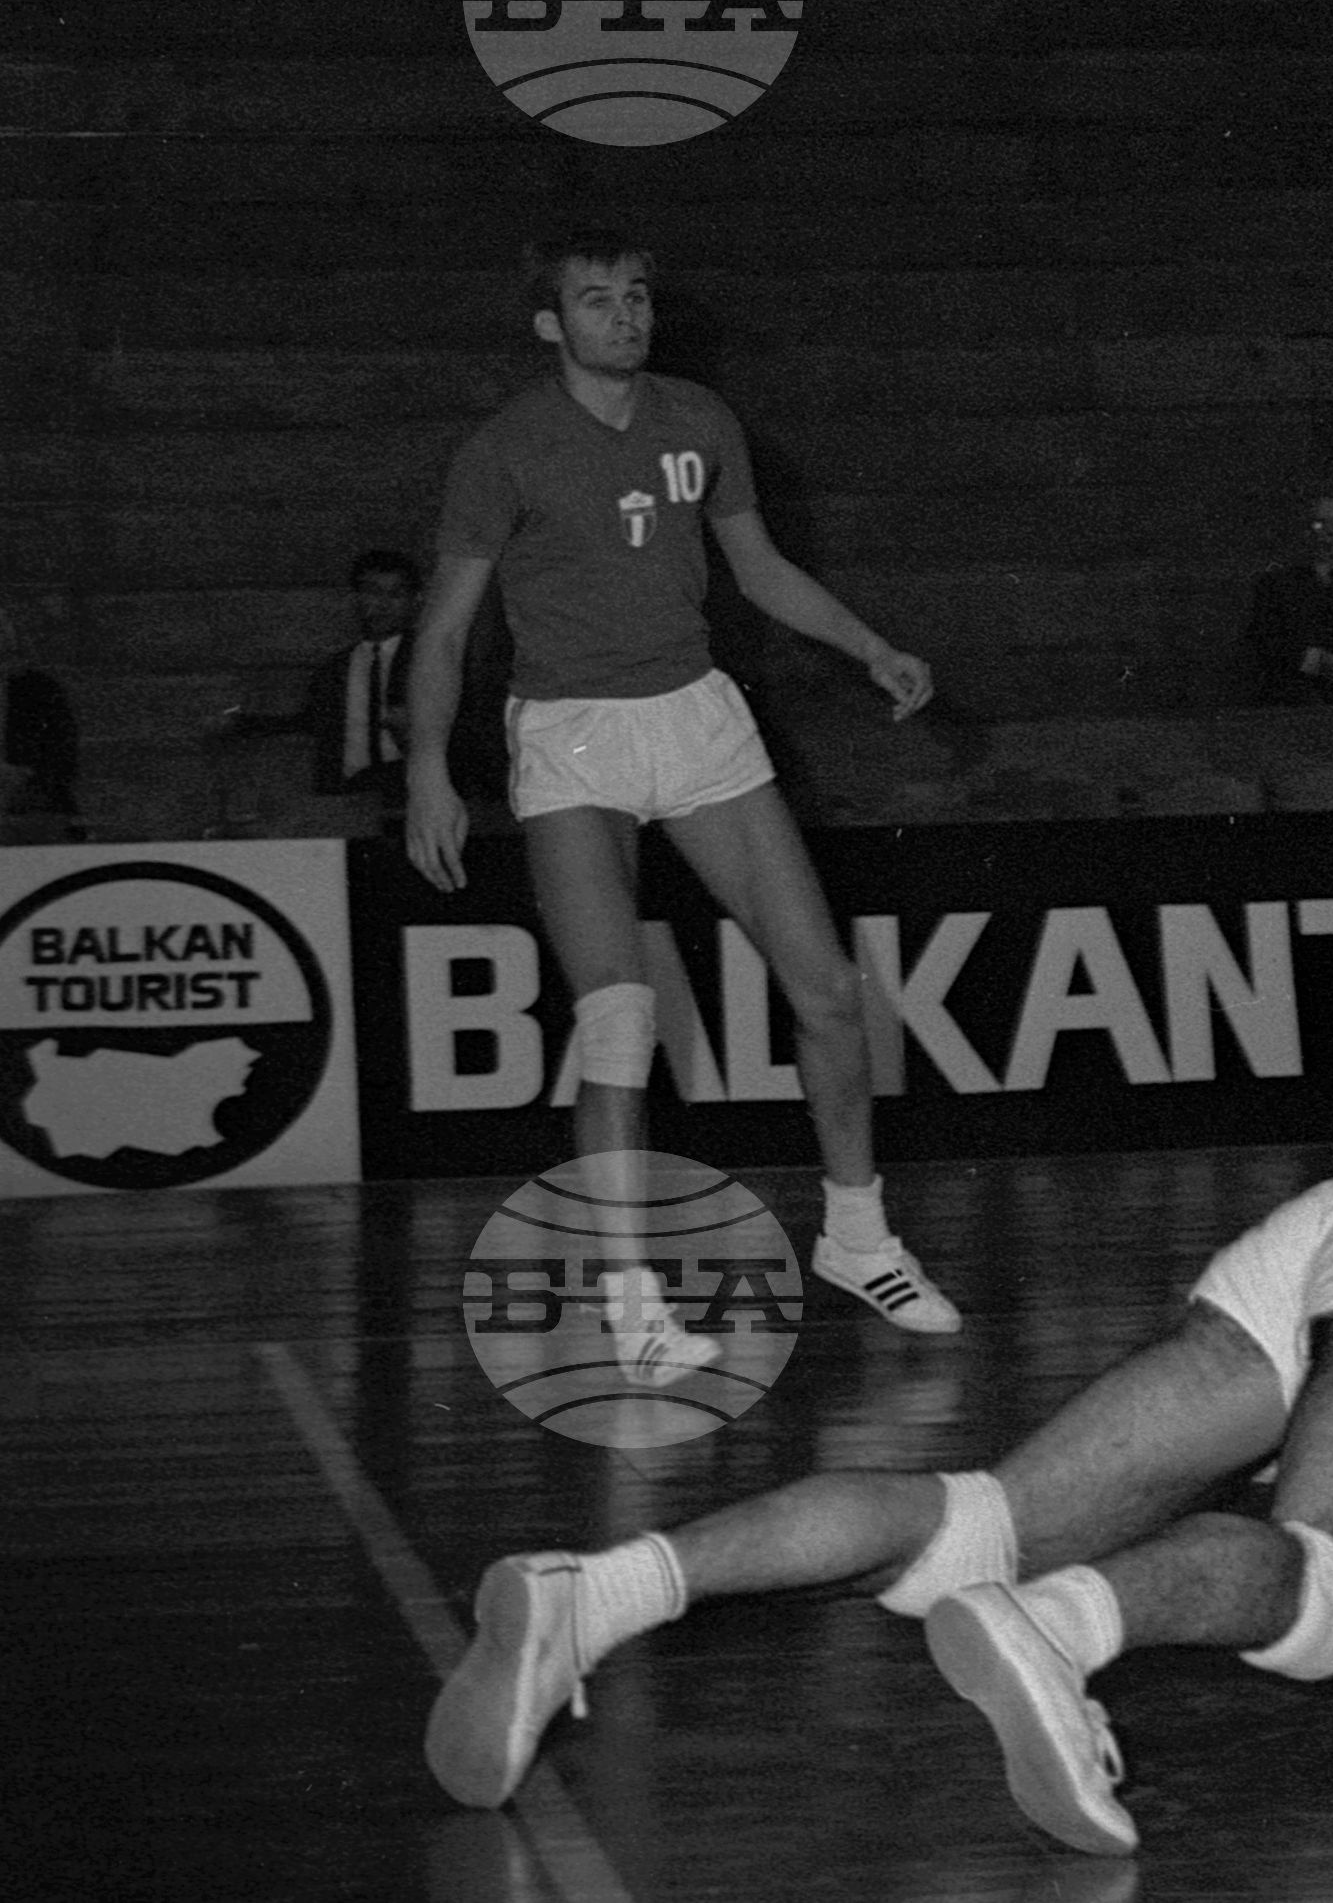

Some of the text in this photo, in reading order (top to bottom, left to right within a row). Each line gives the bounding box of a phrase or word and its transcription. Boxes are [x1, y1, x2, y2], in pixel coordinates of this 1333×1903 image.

[660, 450, 705, 503] 10
[31, 922, 254, 965] BALKAN
[25, 971, 260, 1012] TOURIST
